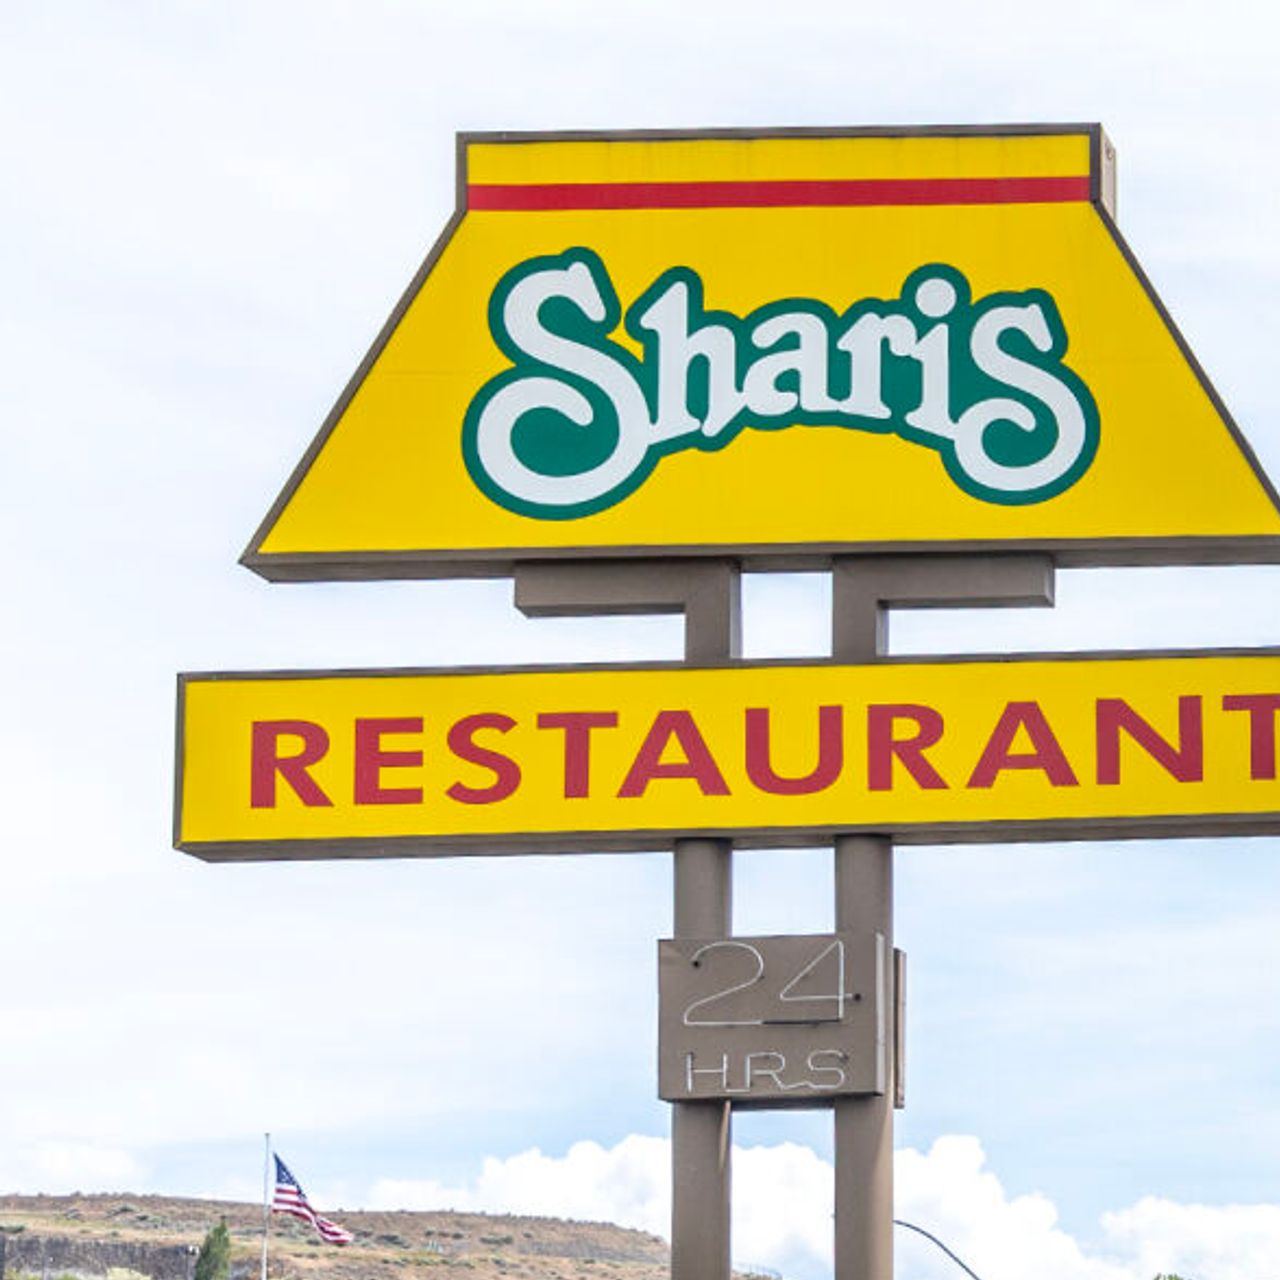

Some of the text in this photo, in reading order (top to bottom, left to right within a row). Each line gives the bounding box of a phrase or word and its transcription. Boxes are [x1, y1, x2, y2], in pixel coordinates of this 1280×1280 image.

[474, 258, 1088, 508] Sharis
[684, 940, 858, 1026] 24
[686, 1051, 847, 1092] HRS
